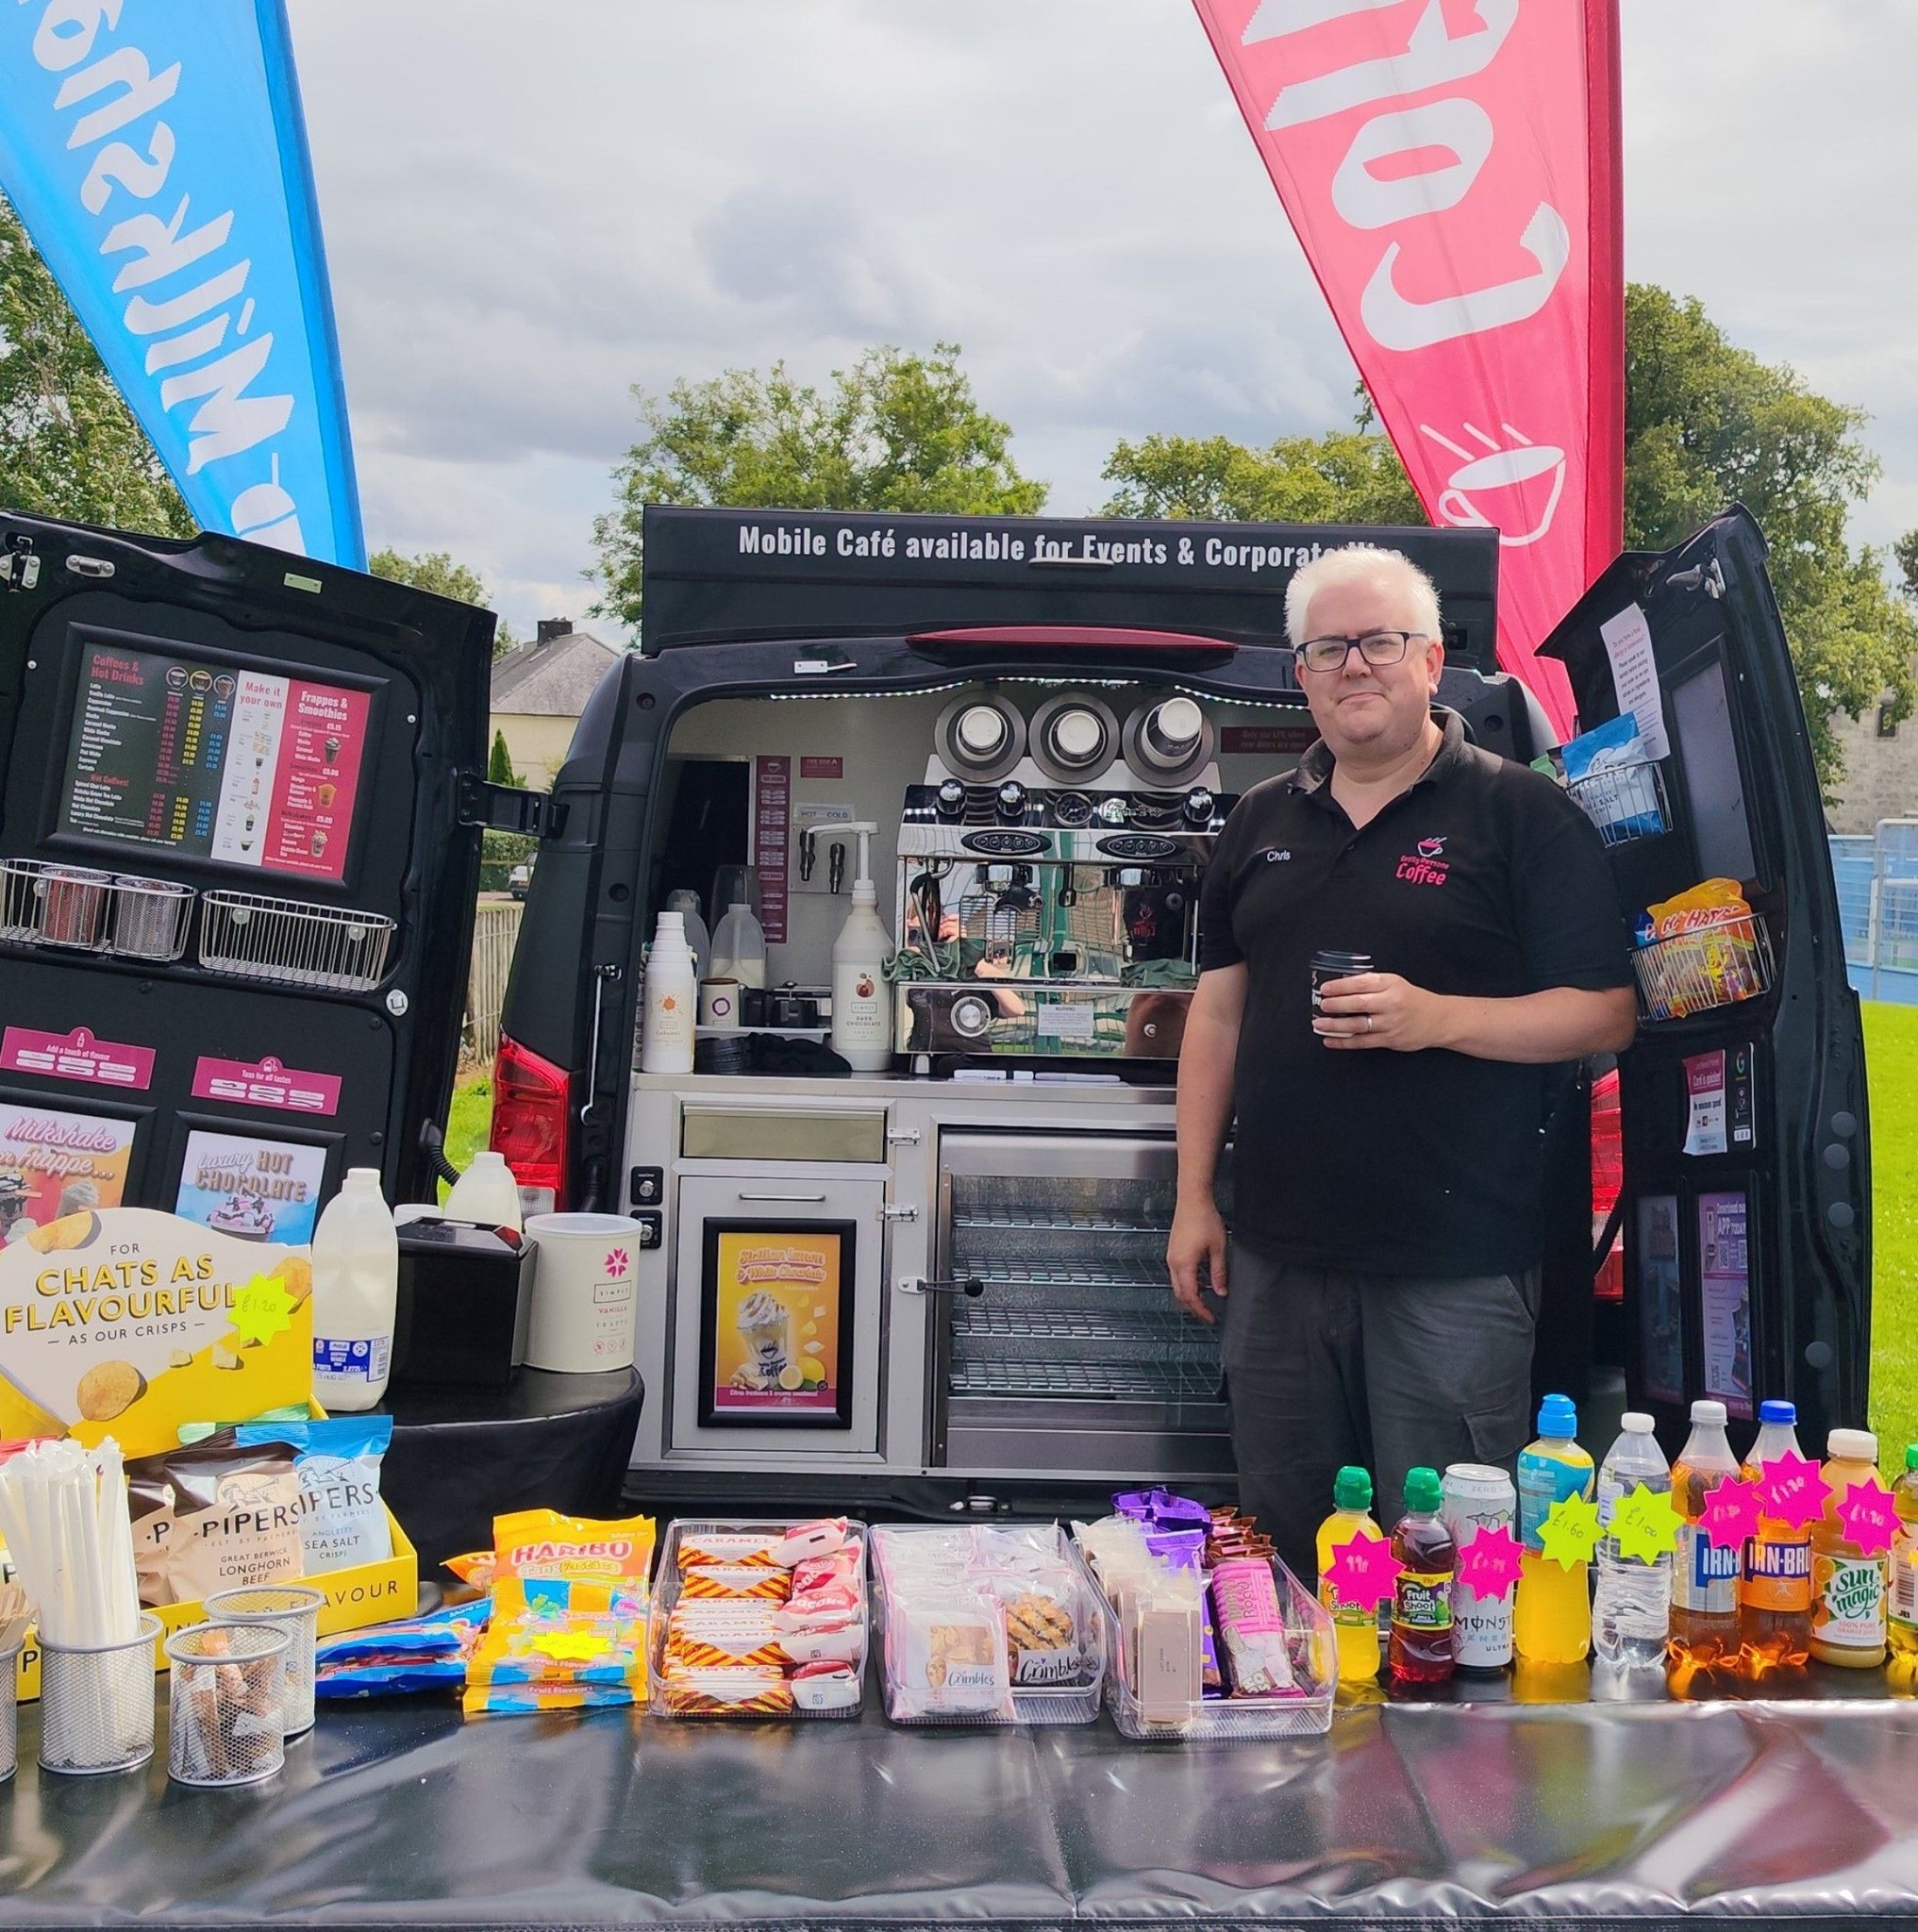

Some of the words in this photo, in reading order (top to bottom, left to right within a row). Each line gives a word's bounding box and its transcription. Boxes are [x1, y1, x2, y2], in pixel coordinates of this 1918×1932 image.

[739, 525, 826, 555] Mobile
[837, 528, 896, 558] Café
[906, 532, 1026, 560] available
[1034, 535, 1073, 559] for
[1084, 535, 1168, 563] Events
[1178, 538, 1194, 565] &
[93, 654, 129, 670] Coffees
[132, 661, 140, 672] &
[92, 666, 108, 679] Hot
[111, 670, 144, 685] Drinks
[245, 681, 271, 694] Make
[274, 686, 280, 696] it
[240, 694, 261, 706] your
[264, 699, 282, 709] own
[301, 691, 339, 707] Frappes
[341, 698, 348, 708] &
[298, 703, 348, 721] Smoothies
[1266, 850, 1292, 862] Chris
[1396, 863, 1446, 885] Coffee
[5, 1116, 116, 1152] Milkshake
[197, 1150, 255, 1177] Luxury
[256, 1149, 295, 1175] HOT
[195, 1169, 309, 1203] CHOCOLATE
[110, 1243, 140, 1256] FOR
[36, 1258, 159, 1297] CHATS
[172, 1253, 215, 1282] AS
[4, 1283, 237, 1334] FLAVOURFUL
[598, 1306, 627, 1314] VANILLA
[69, 1333, 92, 1345] AS
[94, 1328, 132, 1342] OUR
[135, 1323, 188, 1338] CRISPS
[299, 1483, 374, 1514] IPERS
[202, 1502, 299, 1538] PIPERS
[1553, 1510, 1584, 1539] £1.60
[305, 1540, 328, 1550] SEA
[332, 1536, 360, 1548] SALT
[691, 1537, 774, 1545] CARAMEL
[221, 1553, 251, 1563] GREAT
[253, 1548, 288, 1561] BERWICK
[319, 1551, 347, 1559] CRISPS
[513, 1541, 630, 1564] HARIBO
[220, 1557, 291, 1576] LONGHORN
[242, 1573, 270, 1586] BEEF
[1836, 1569, 1880, 1592] sun
[1407, 1590, 1431, 1601] Fruit
[1833, 1585, 1880, 1619] magic
[1405, 1601, 1435, 1611] Shoot
